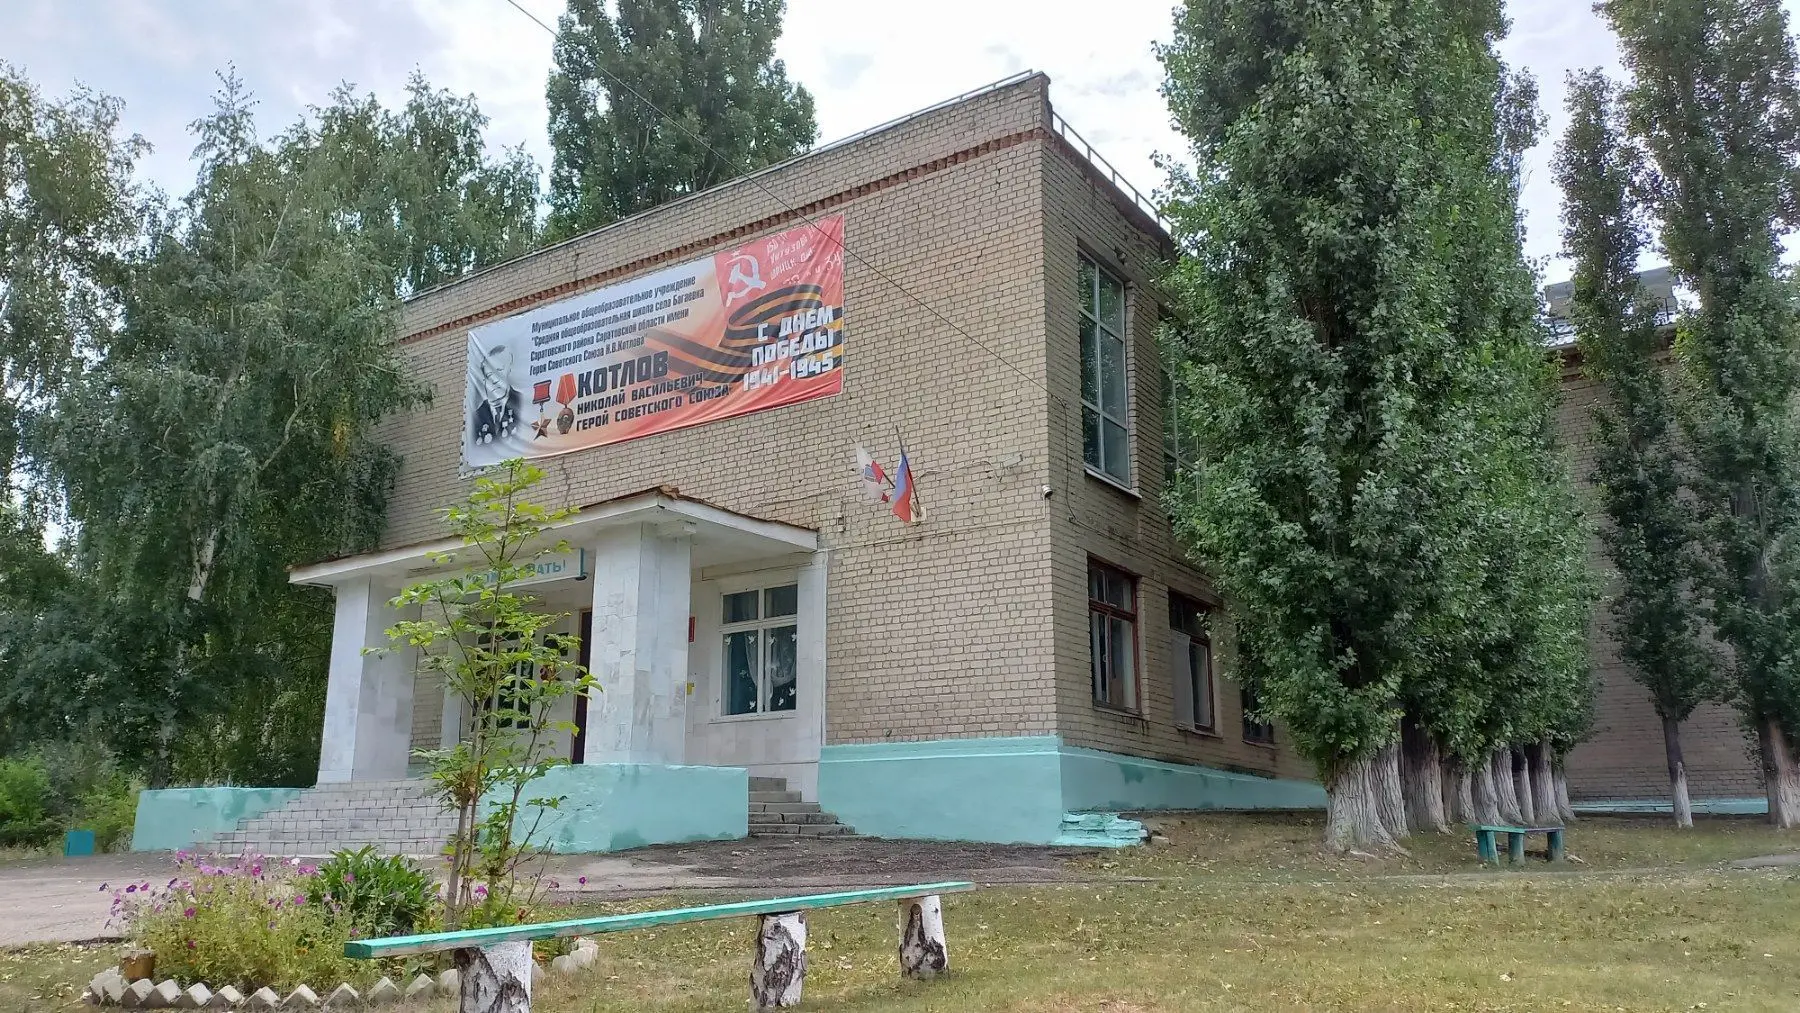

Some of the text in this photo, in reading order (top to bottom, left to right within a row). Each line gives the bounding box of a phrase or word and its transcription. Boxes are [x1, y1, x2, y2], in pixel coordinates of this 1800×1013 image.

[531, 276, 696, 333] Муниципальное общеобразовательное учреждение
[531, 332, 560, 347] "Средняя
[561, 310, 631, 339] общеобразовательная
[632, 304, 654, 318] школа
[655, 299, 671, 311] села
[757, 305, 834, 342] С ДНЕМ
[530, 308, 689, 362] Саратовского района Саратовской области имени
[752, 328, 834, 367] ПОБЕДЫ
[530, 364, 547, 376] Героя
[548, 353, 582, 371] Советского
[584, 347, 604, 361] Союза
[577, 350, 669, 399] КОТЛОВ
[743, 352, 834, 392] 1941-1945
[576, 383, 731, 432] ГЕРОЙ СОВЕТСКОГО СОЮЗА
[577, 372, 703, 415] НИКОЛАЙ ВАСИЛЬЕВИЧ
